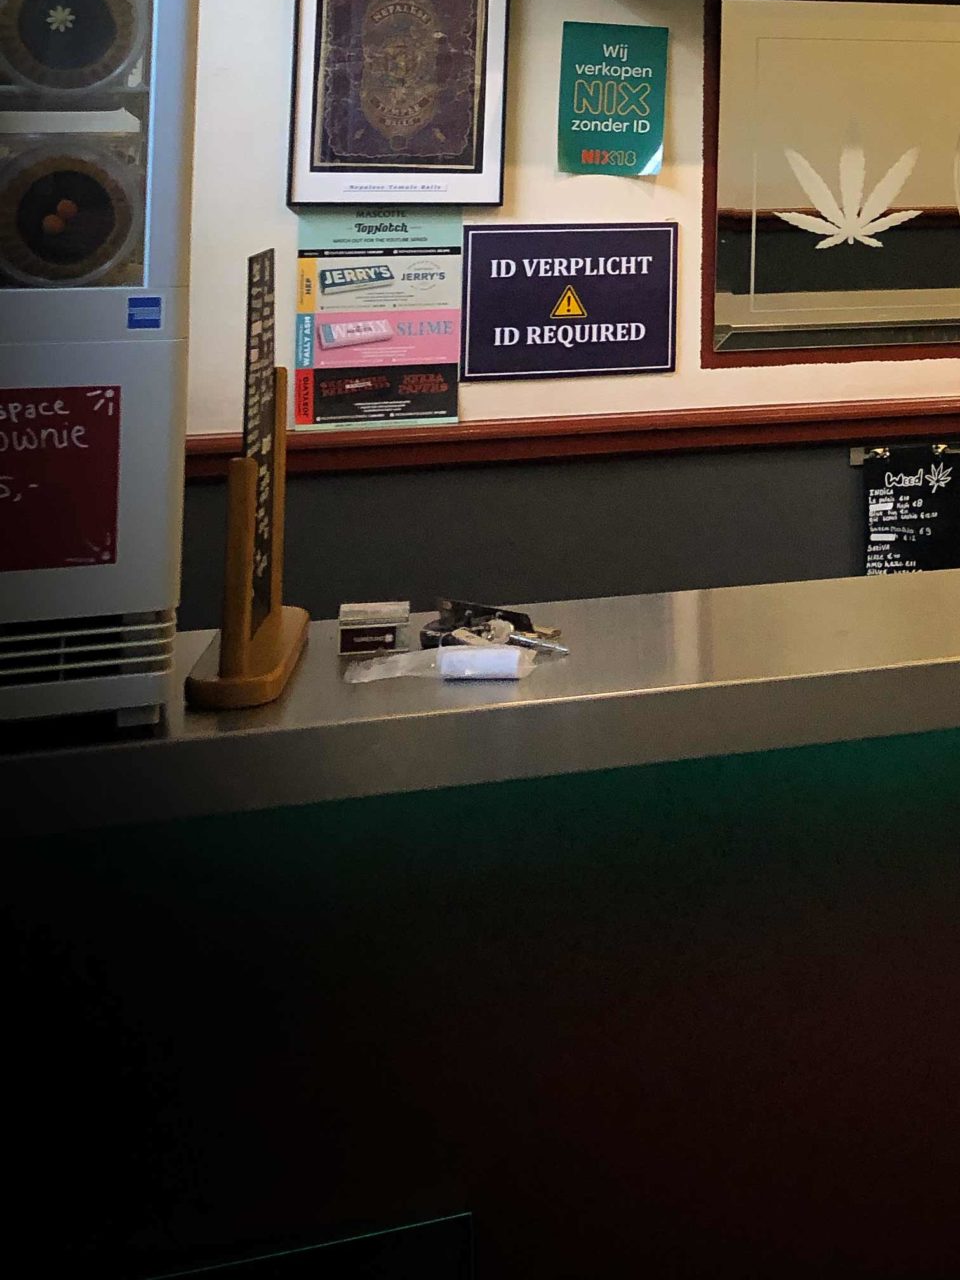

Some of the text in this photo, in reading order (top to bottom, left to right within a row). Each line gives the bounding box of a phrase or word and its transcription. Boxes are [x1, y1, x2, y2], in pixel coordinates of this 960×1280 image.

[603, 44, 628, 62] Wij
[575, 62, 652, 80] verkopen
[574, 80, 650, 116] NIX
[571, 118, 650, 133] zonder ID
[581, 149, 636, 166] NIX18
[354, 223, 409, 235] TopNotch
[324, 266, 391, 285] JERRY'S
[490, 256, 653, 278] ID VERPLICHT
[401, 272, 446, 281] JERRY'S
[303, 316, 311, 367] WALLY ASH
[494, 323, 646, 348] ID REQUIRED
